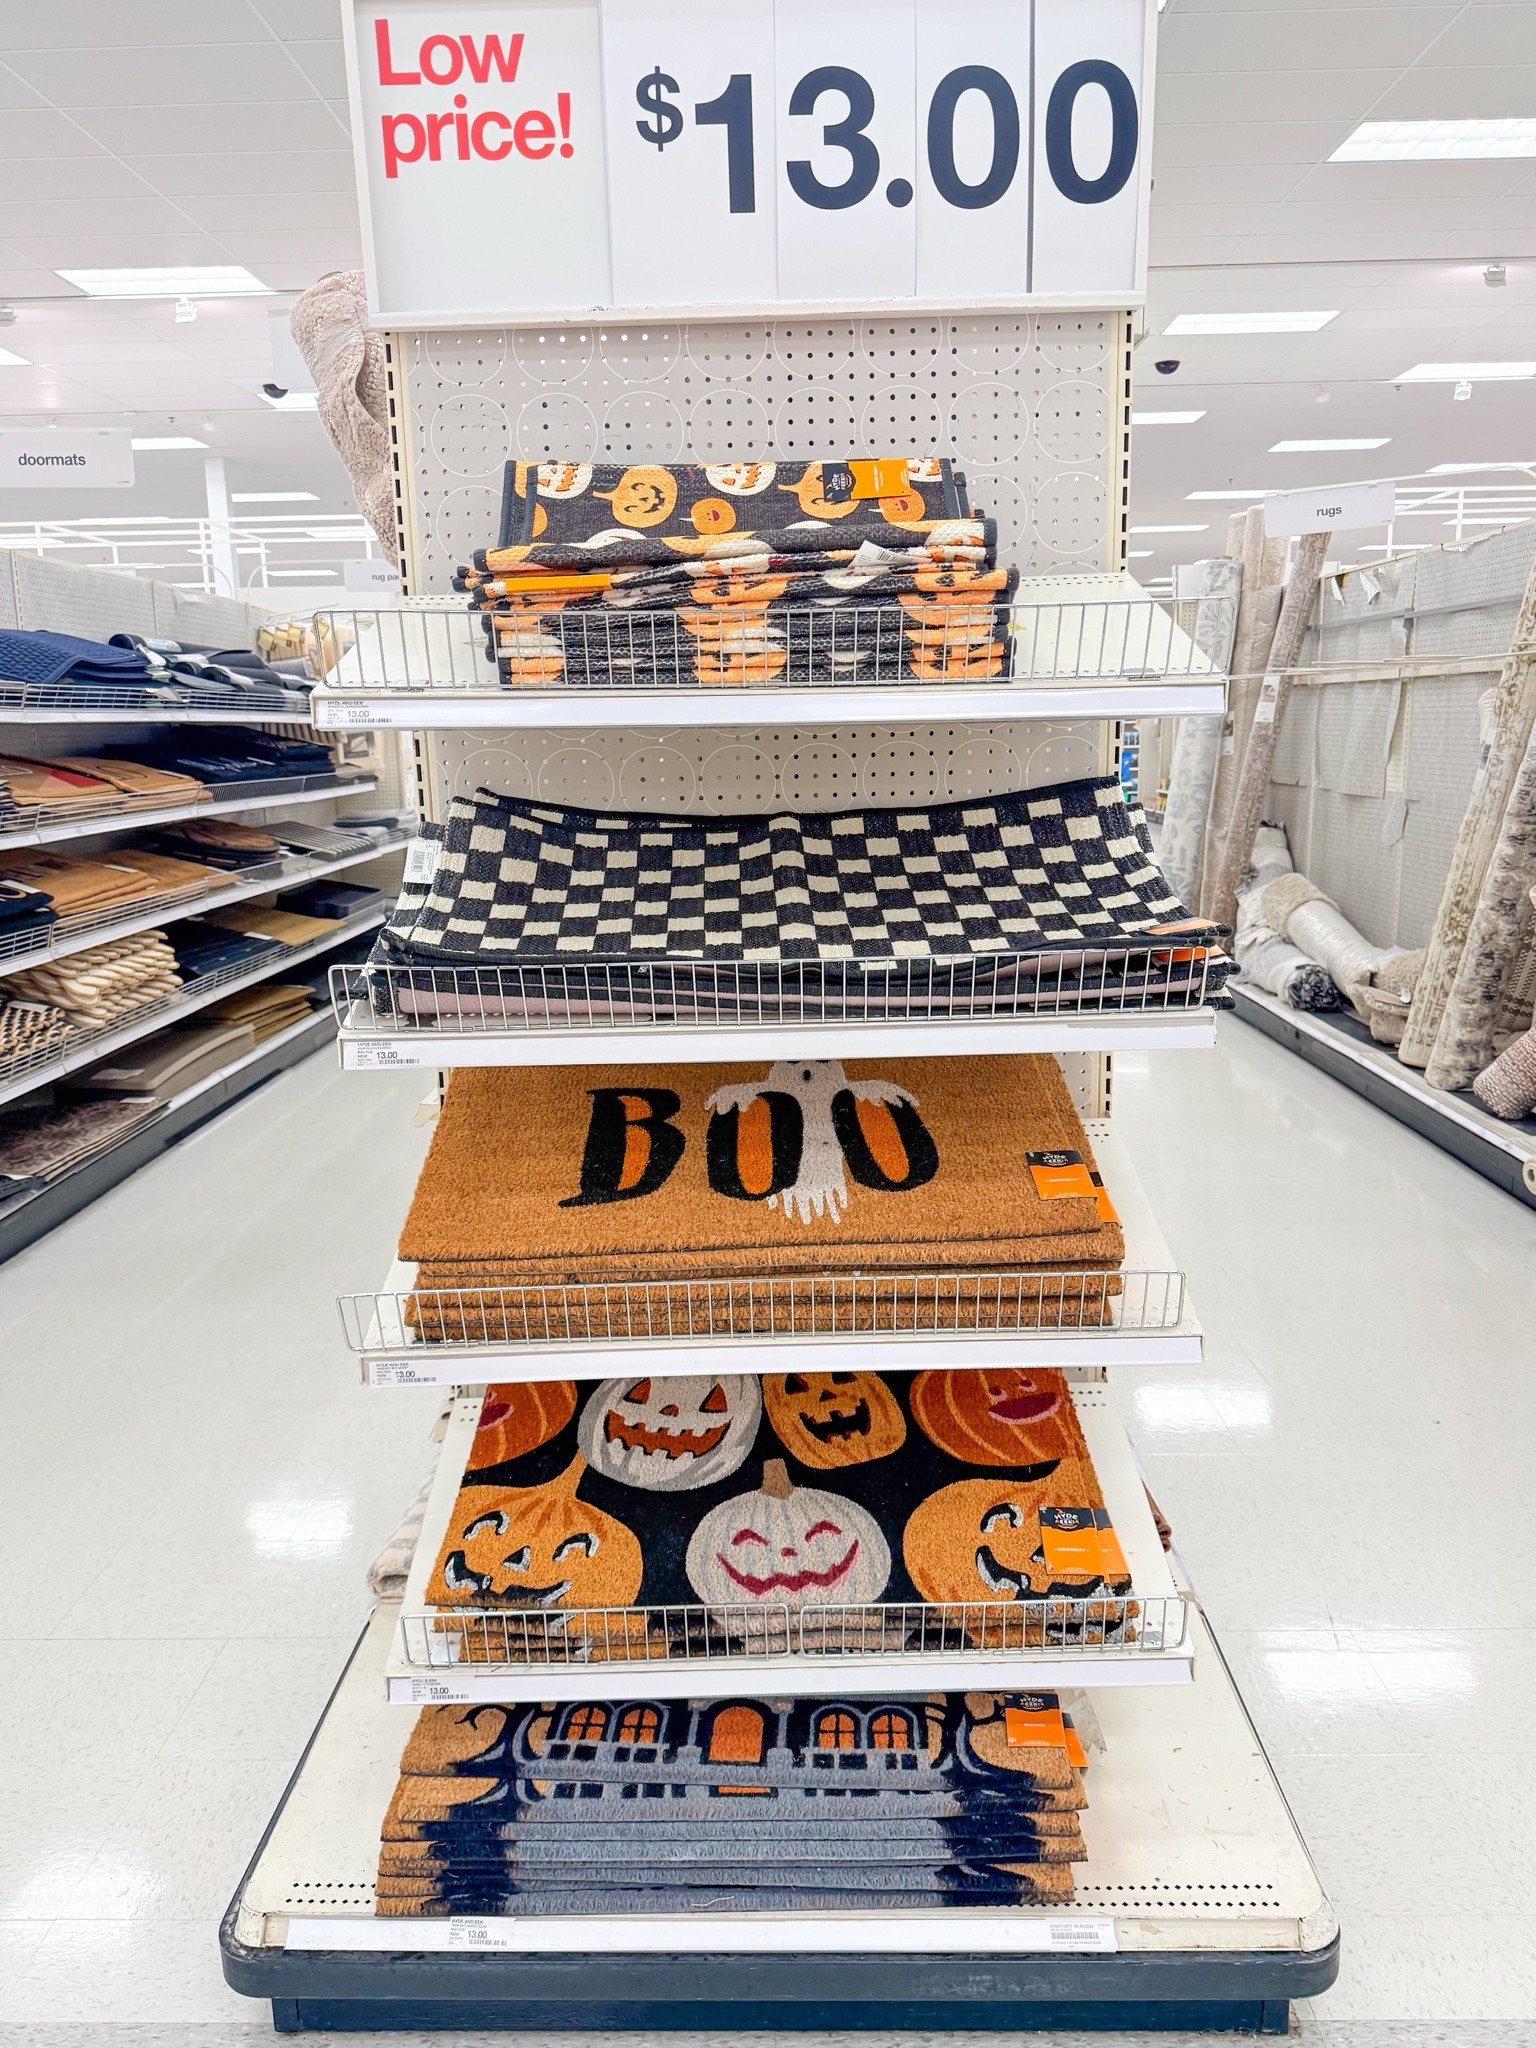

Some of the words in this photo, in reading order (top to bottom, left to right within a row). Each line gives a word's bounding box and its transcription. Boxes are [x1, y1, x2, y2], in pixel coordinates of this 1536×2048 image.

[375, 18, 524, 87] Low
[381, 92, 575, 179] price!
[635, 58, 1140, 214] $13.00
[18, 453, 87, 466] doormats
[1316, 506, 1343, 518] rugs
[371, 574, 386, 583] rug
[387, 574, 400, 582] pa
[347, 710, 370, 718] 13.00
[376, 1051, 398, 1059] 13.00
[558, 1087, 940, 1210] BOO
[395, 1370, 416, 1378] 13.00
[429, 1687, 449, 1695] 13.00
[467, 1930, 488, 1939] 13.00
